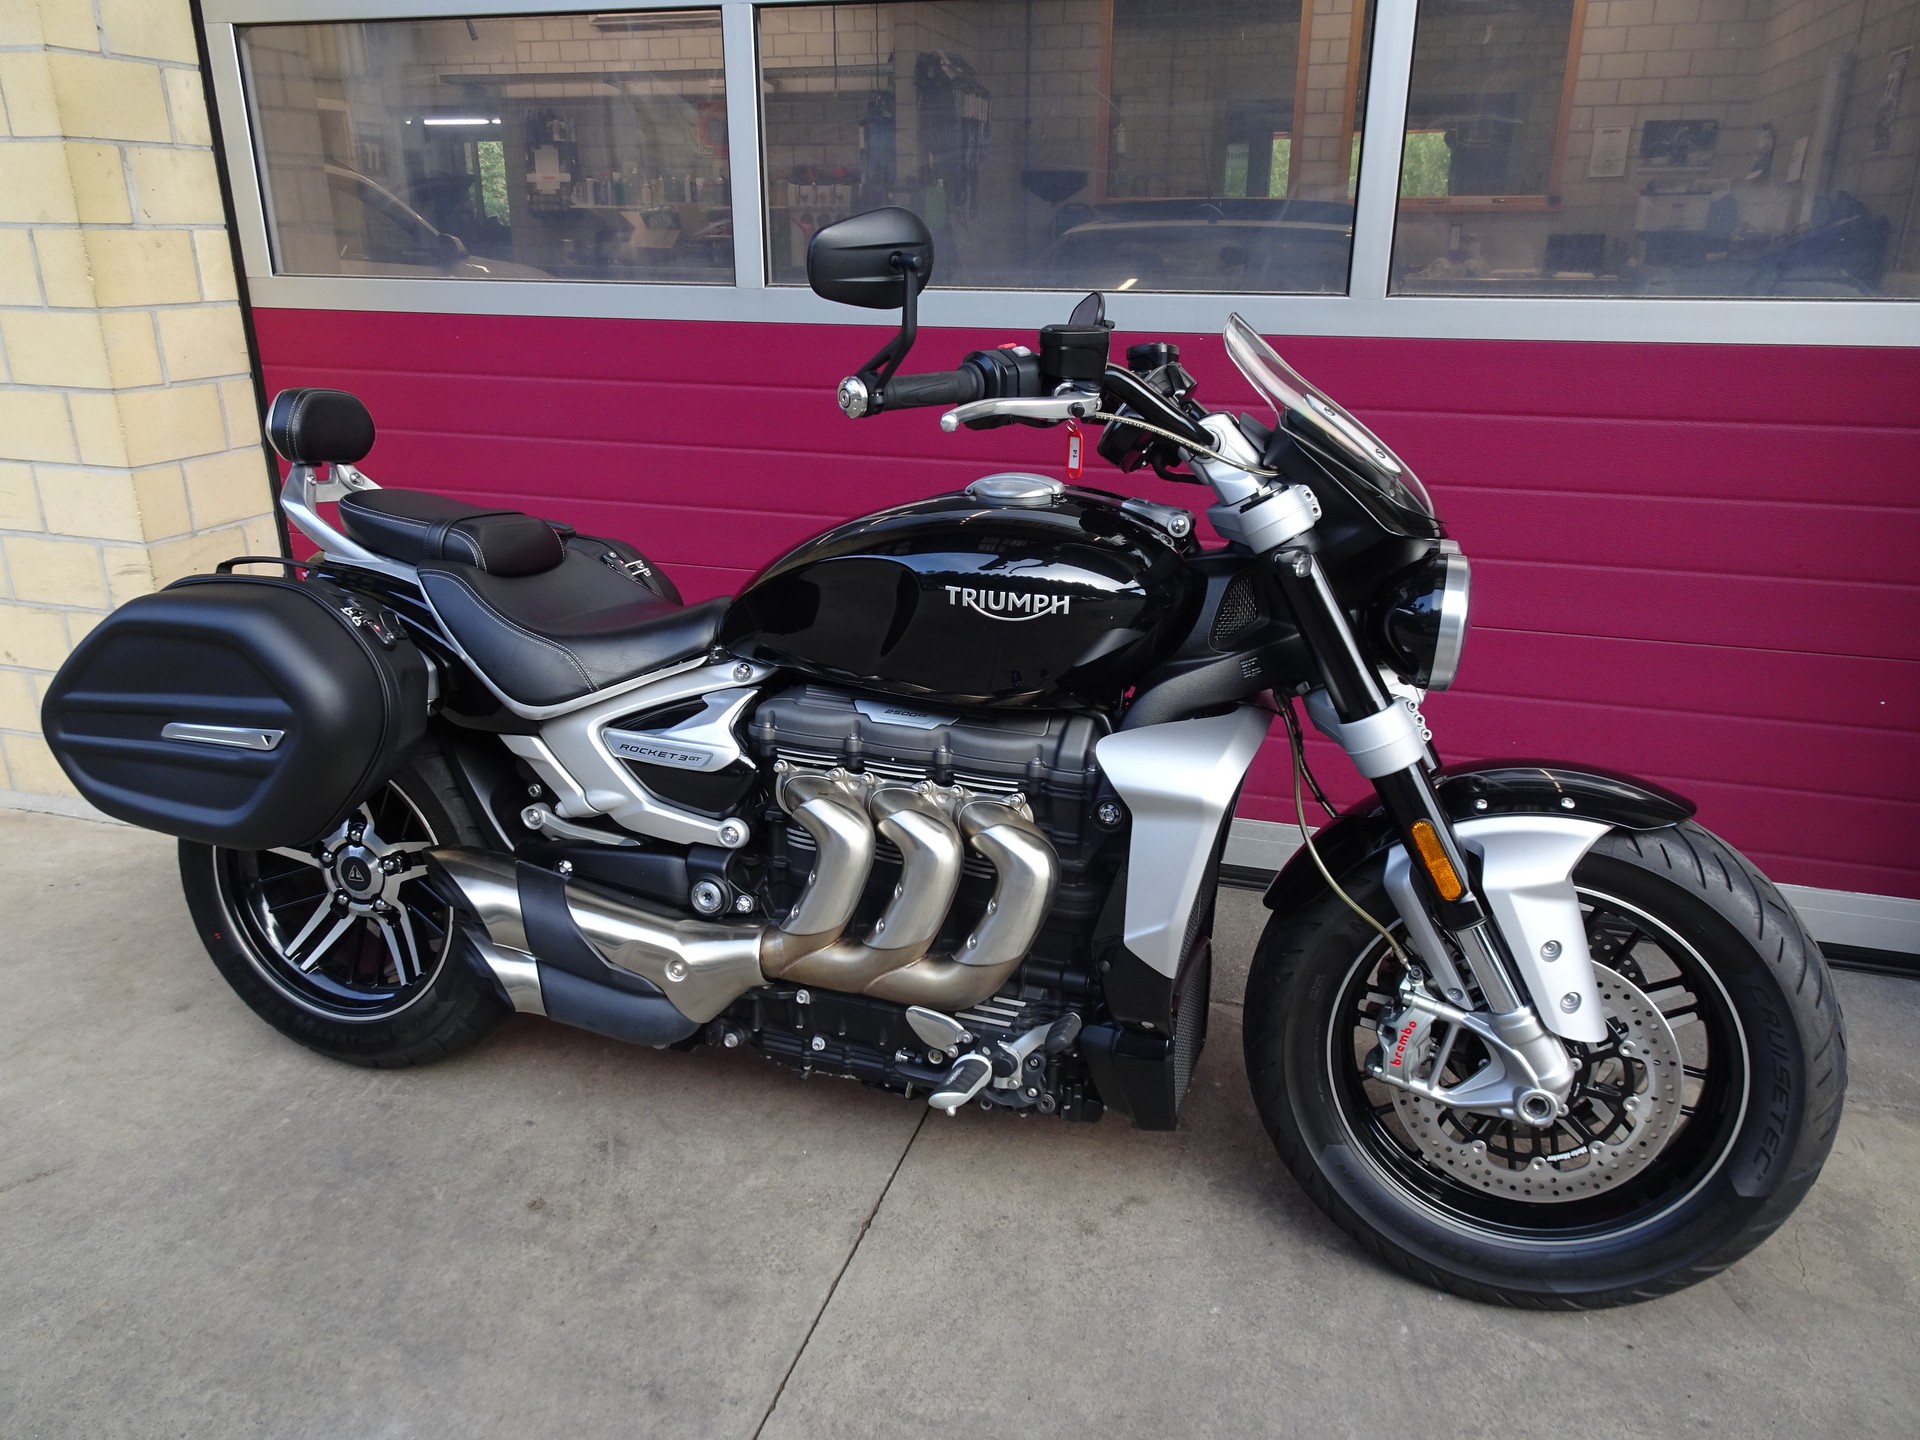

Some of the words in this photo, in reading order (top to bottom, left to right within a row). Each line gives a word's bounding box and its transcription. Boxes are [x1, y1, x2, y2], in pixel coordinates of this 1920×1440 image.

[944, 585, 1070, 621] TRIUMPH
[1389, 1020, 1417, 1067] brembo
[1748, 984, 1791, 1180] CRUISETEC
